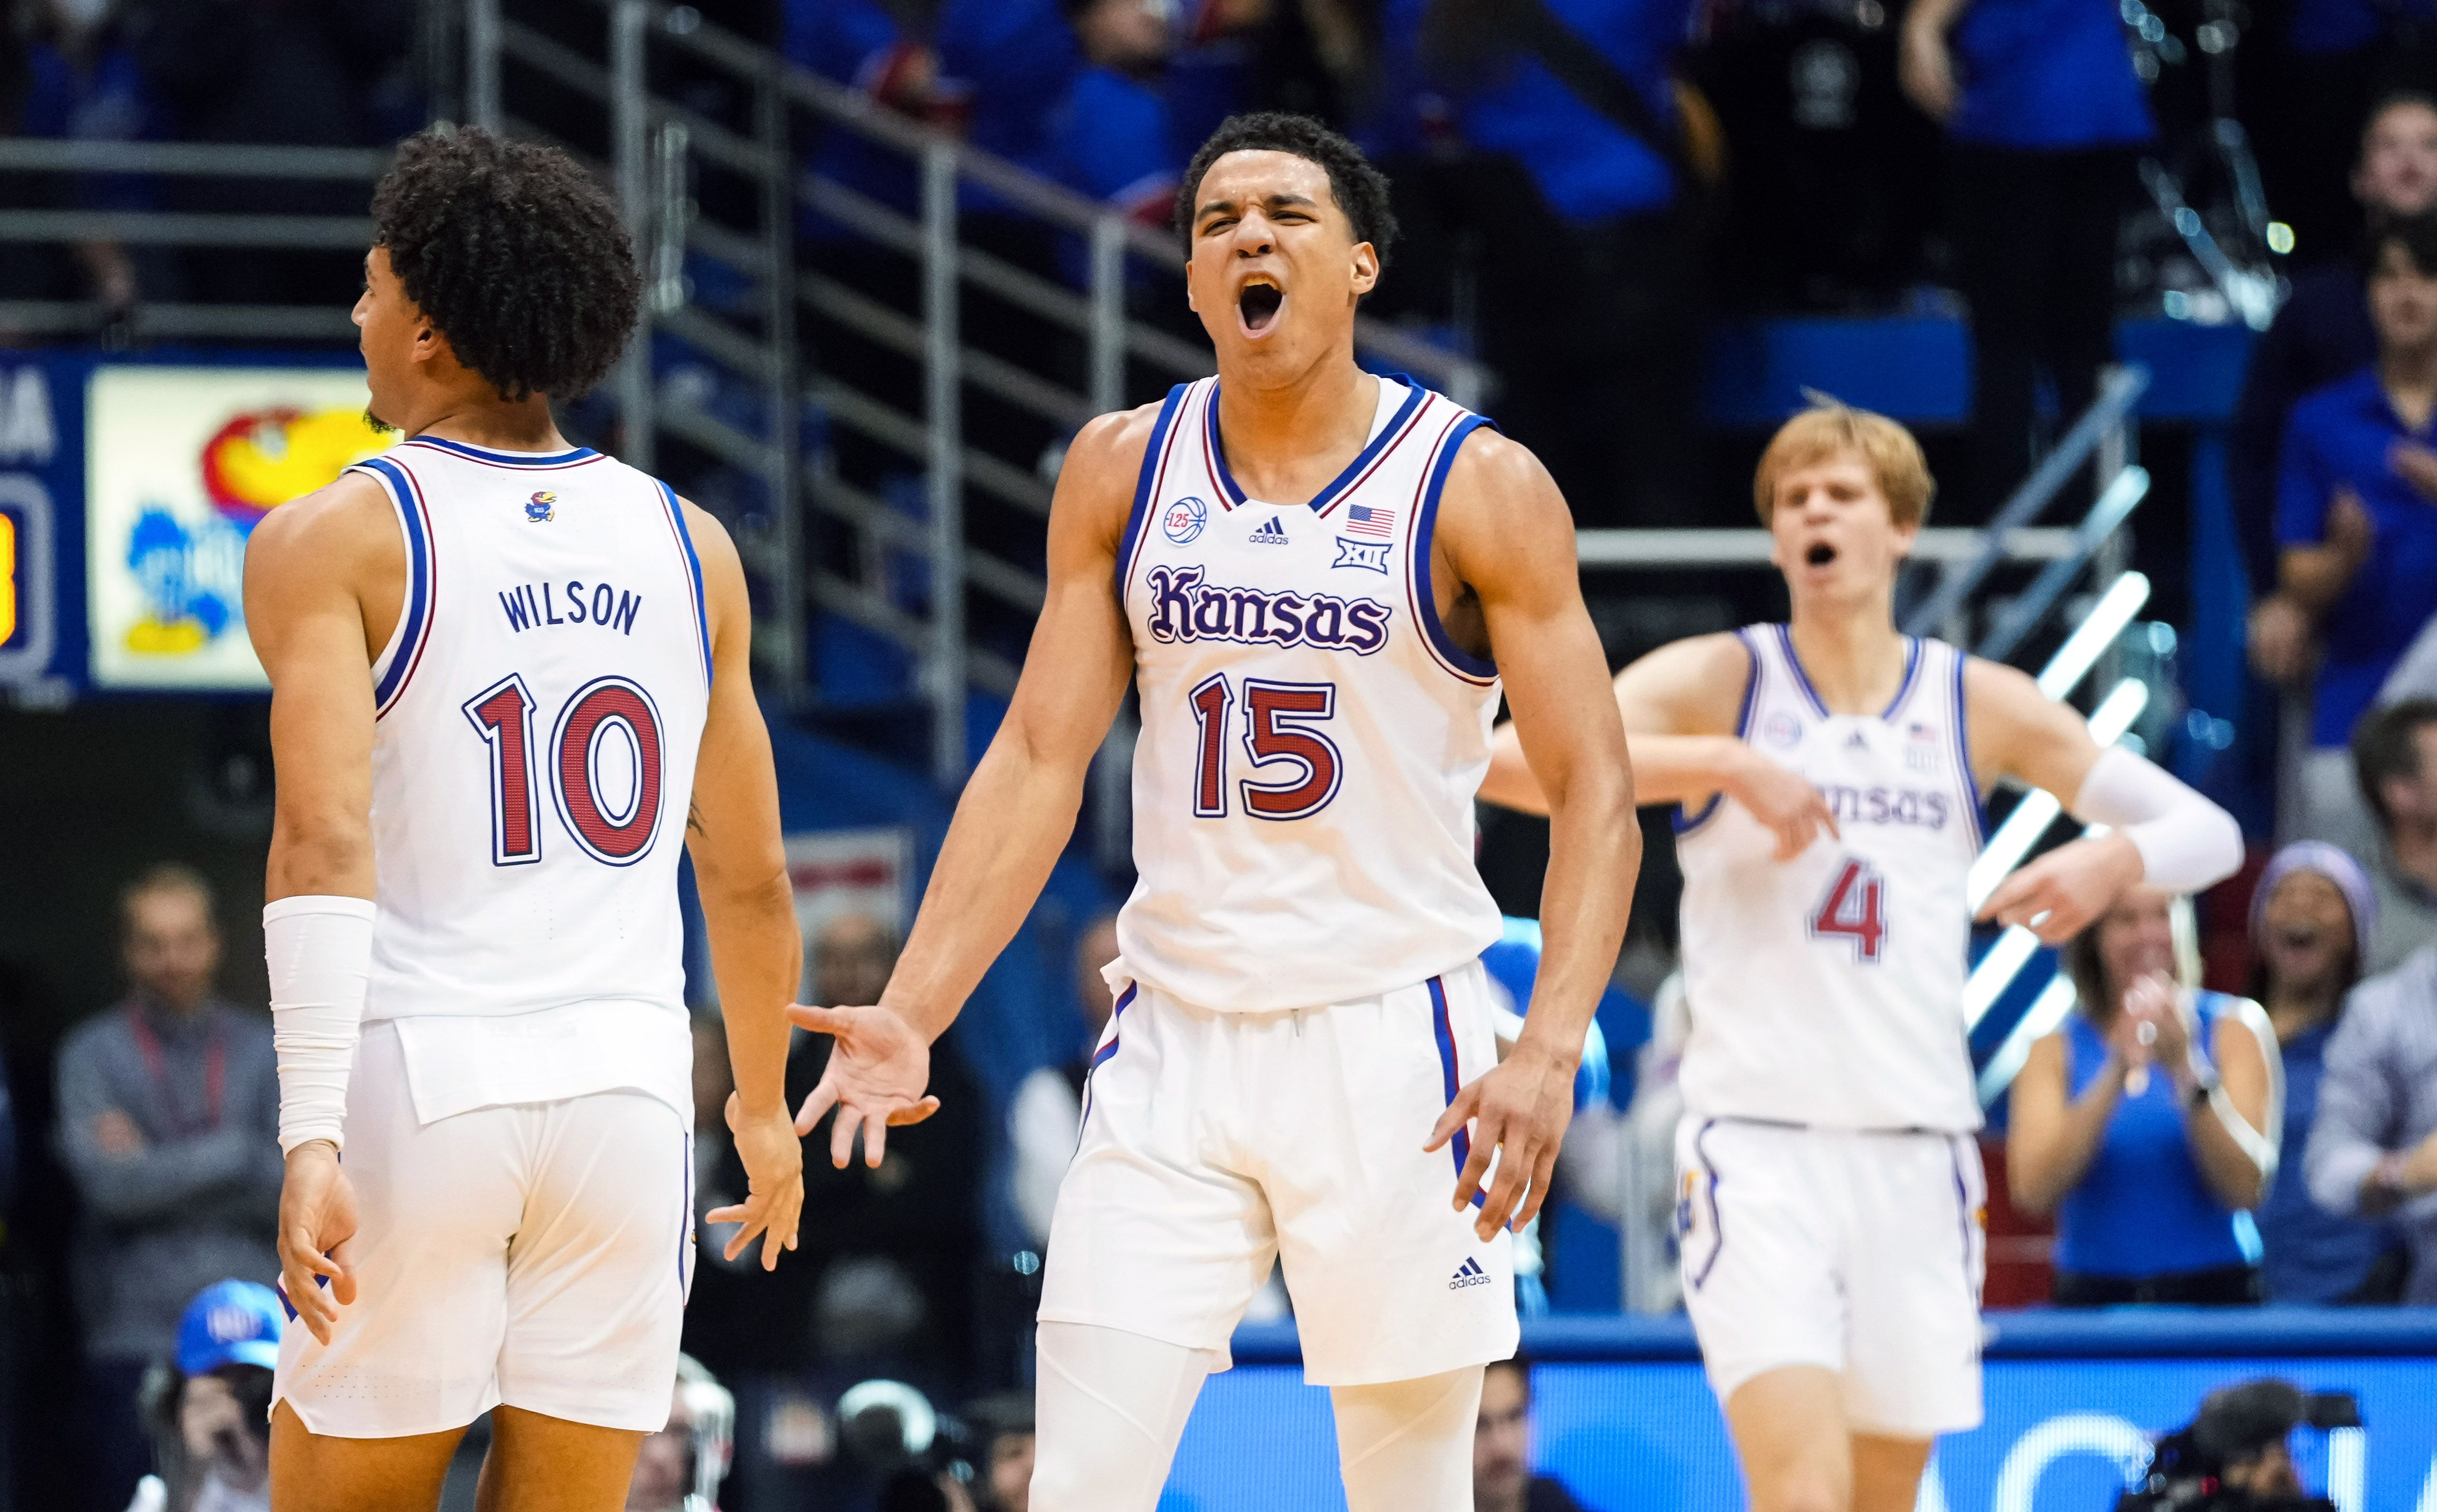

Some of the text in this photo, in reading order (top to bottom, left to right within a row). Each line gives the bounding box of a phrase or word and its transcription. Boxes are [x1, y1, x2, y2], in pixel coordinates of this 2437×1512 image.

[1167, 513, 1189, 527] 125
[1249, 534, 1288, 545] adidas
[1333, 537, 1392, 574] XII
[499, 581, 642, 635] WILSON
[1147, 565, 1391, 656] Kansas
[461, 672, 665, 867] 10
[1189, 672, 1343, 821] 15
[1813, 783, 1948, 830] nsas
[1809, 855, 1888, 964] 4
[1449, 1274, 1491, 1290] adidas
